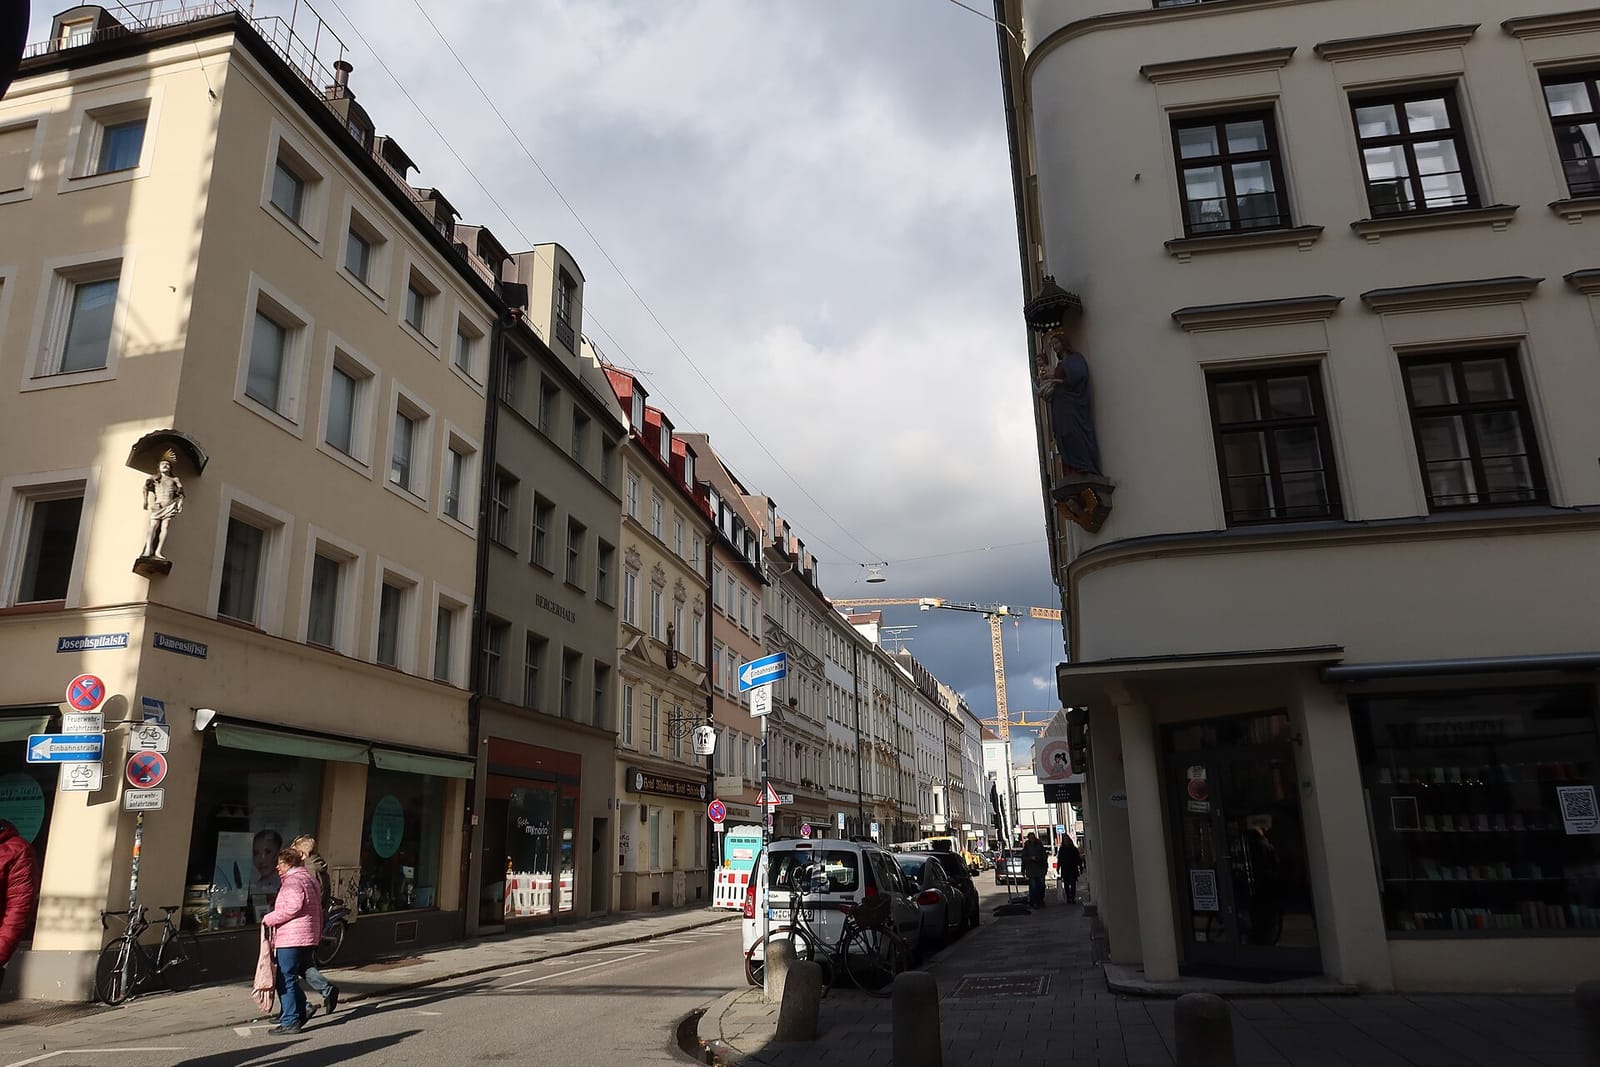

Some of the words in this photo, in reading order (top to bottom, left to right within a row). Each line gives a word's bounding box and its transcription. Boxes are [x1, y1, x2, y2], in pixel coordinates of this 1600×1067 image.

[535, 593, 576, 624] BERGERHAUS
[59, 635, 126, 649] Josephspitalstr.
[49, 744, 99, 752] Einbahnstraße
